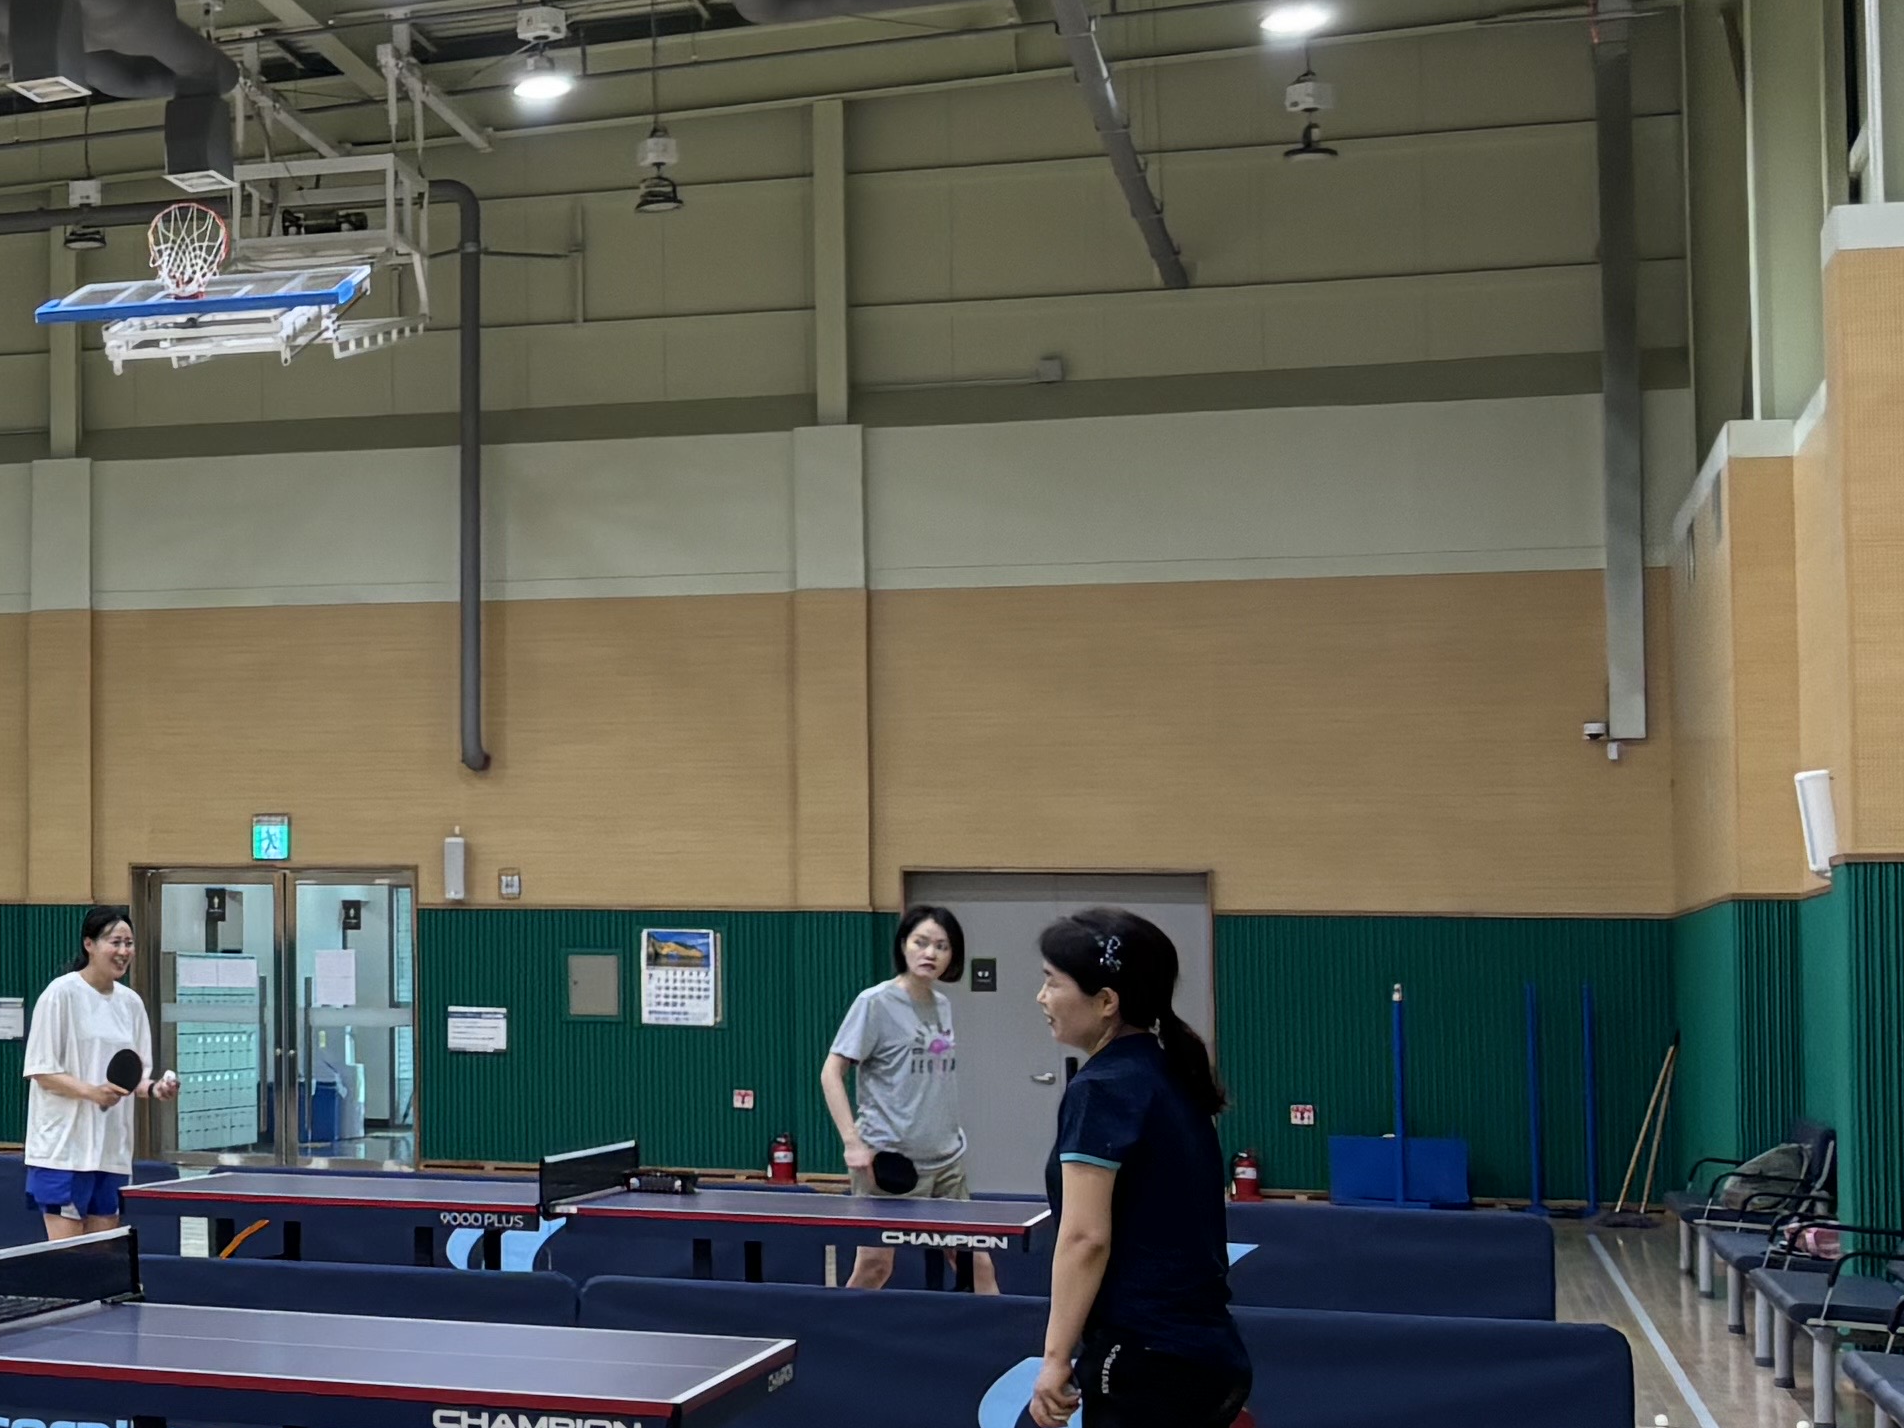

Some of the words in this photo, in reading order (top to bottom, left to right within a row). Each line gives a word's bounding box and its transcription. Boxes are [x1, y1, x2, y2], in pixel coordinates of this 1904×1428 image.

[440, 1212, 482, 1226] 9000
[484, 1213, 524, 1228] PLUS
[881, 1231, 1009, 1249] CHAMPION
